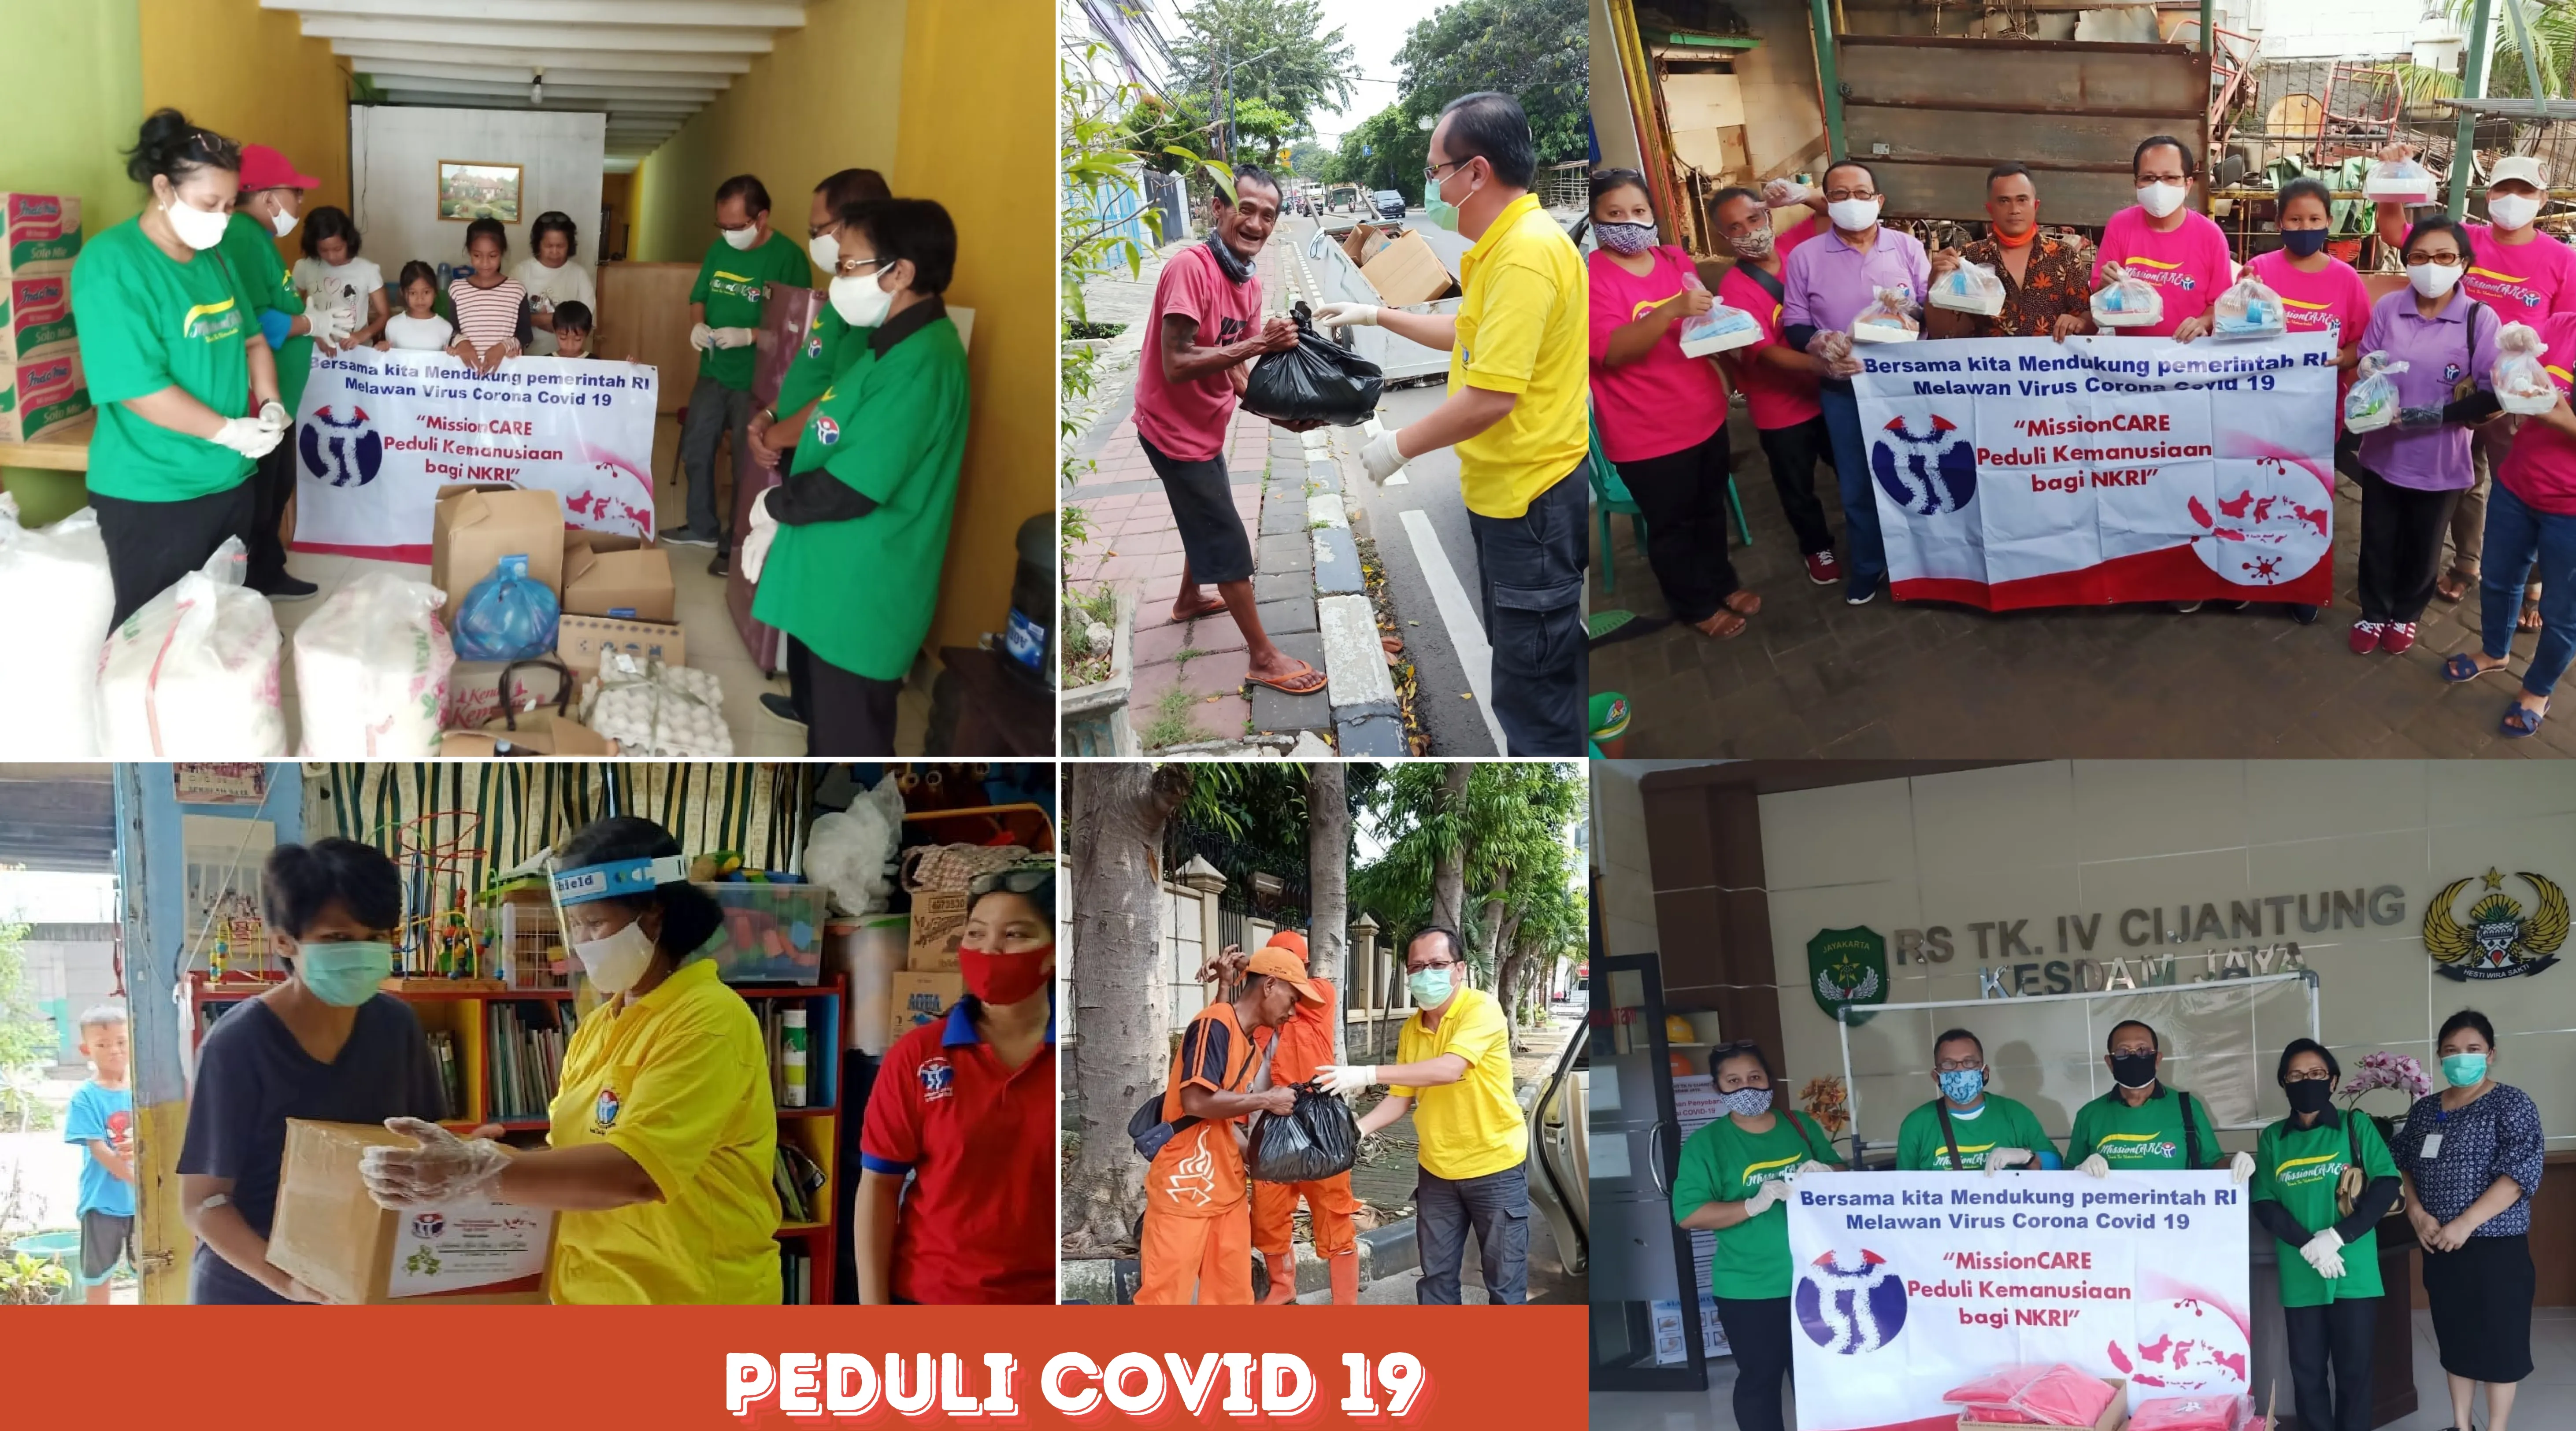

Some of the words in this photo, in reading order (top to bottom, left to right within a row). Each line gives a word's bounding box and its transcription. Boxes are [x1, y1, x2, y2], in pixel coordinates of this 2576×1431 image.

[311, 358, 378, 375] Bersama
[385, 364, 418, 377] kita
[425, 366, 521, 385] Mendukung
[527, 372, 625, 388] pemerintah
[632, 377, 649, 390] RI
[1865, 358, 1961, 374] Bersama
[1968, 356, 2011, 372] kita
[2018, 355, 2150, 377] Mendukung
[2157, 354, 2294, 375] pemerintah
[2303, 352, 2327, 367] RI
[346, 378, 415, 396] Melawan
[423, 385, 467, 399] Virus
[473, 388, 531, 403] Corona
[538, 392, 585, 405] Covid
[593, 395, 612, 407] 19
[1913, 380, 2012, 396] Melawan
[2018, 379, 2078, 396] Virus
[2085, 377, 2165, 393] Corona
[2174, 375, 2240, 391] Covid
[2247, 375, 2275, 392] 19
[384, 437, 437, 453] Peduli
[443, 440, 562, 460] Kemanusiaan
[1977, 446, 2047, 466] Peduli
[2052, 442, 2212, 462] Kemanusiaan
[425, 459, 462, 479] bagi
[2031, 469, 2084, 492] bagi
[556, 874, 593, 891] hield
[1895, 926, 1955, 965] RS
[1968, 919, 2043, 959] TK.
[2058, 913, 2102, 954] IV
[2120, 885, 2406, 947] CIJANTUNG
[1823, 940, 1870, 954] JAYAKARTA
[1980, 953, 2176, 1000] KESDAM
[2194, 942, 2308, 983] JAYA
[2463, 969, 2485, 978] HESTI
[2508, 963, 2530, 976] SAKTI
[1801, 1190, 1895, 1207] Bersama
[1902, 1189, 1943, 1206] kita
[1950, 1187, 2074, 1208] Mendukung
[2081, 1189, 2206, 1207] pemerintah
[2214, 1188, 2237, 1205] RI
[1846, 1214, 1942, 1230] Melawan
[1949, 1213, 2005, 1230] Virus
[2013, 1213, 2088, 1230] Corona
[2097, 1213, 2155, 1230] Covid
[2163, 1214, 2190, 1230] 19
[1907, 1280, 1973, 1298] Peduli
[1979, 1281, 2131, 1300] Kemanusiaan
[1959, 1309, 2009, 1329] bagi
